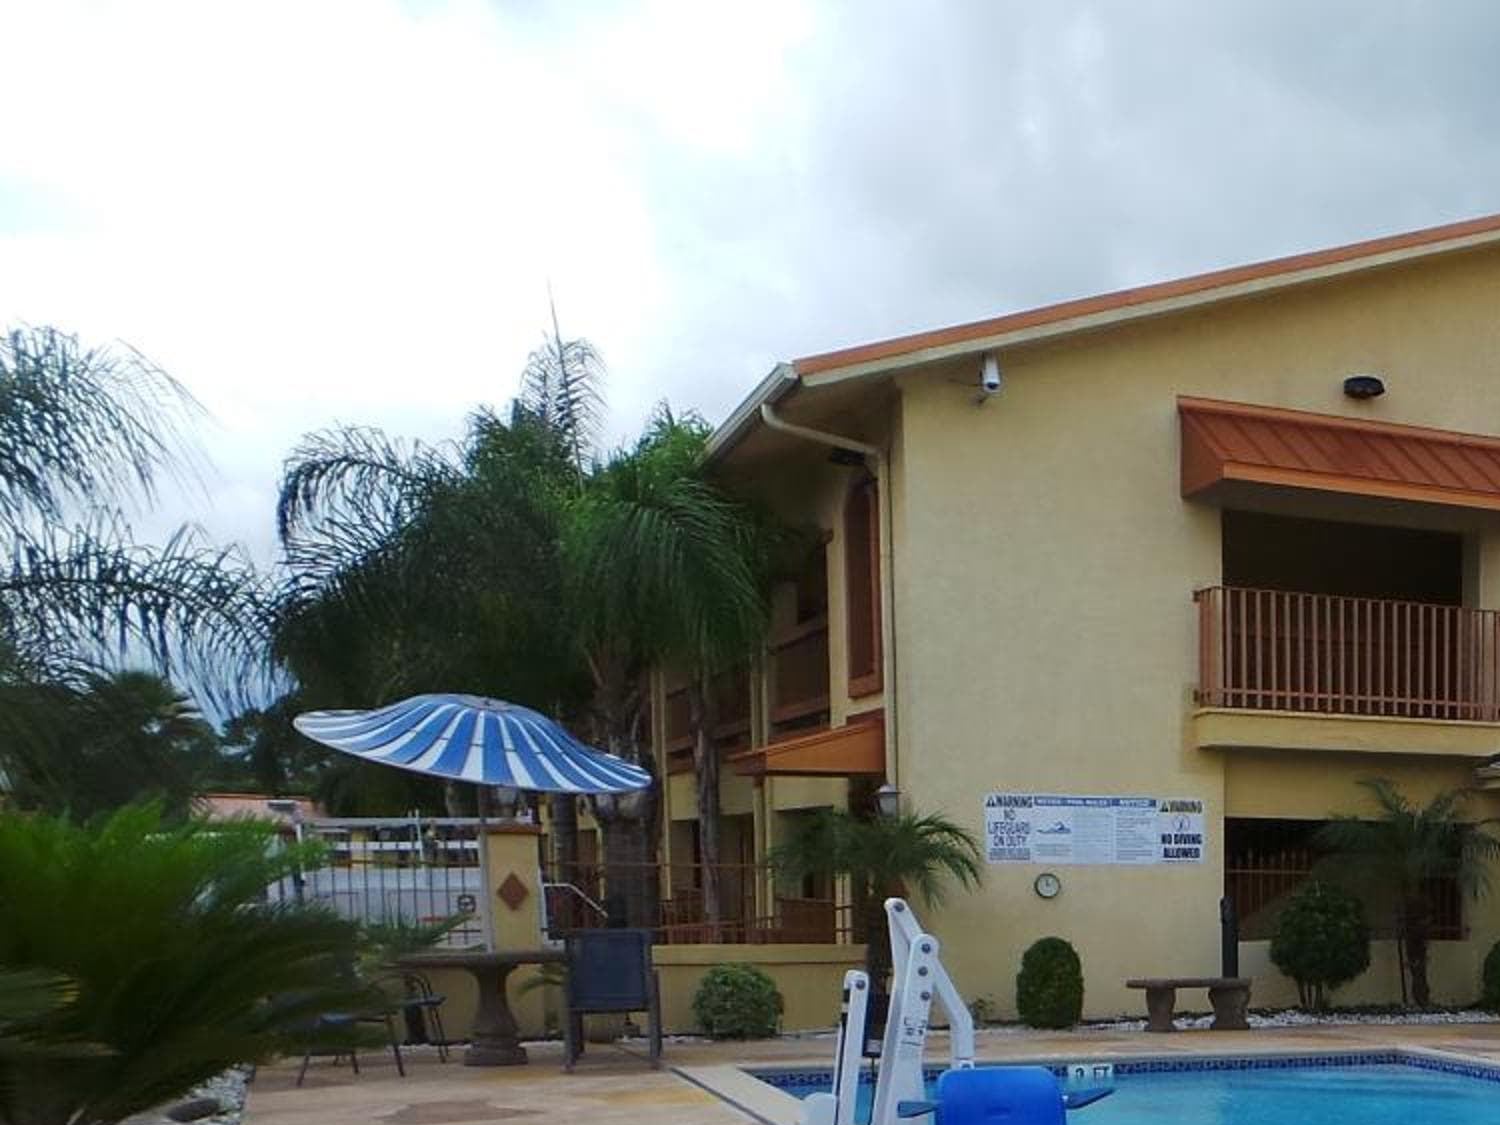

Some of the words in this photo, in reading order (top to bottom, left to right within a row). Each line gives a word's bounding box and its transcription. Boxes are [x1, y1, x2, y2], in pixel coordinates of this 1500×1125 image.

[988, 821, 1030, 835] LIFEGUARD
[993, 834, 1006, 847] ON
[1161, 833, 1173, 845] NO
[1173, 833, 1203, 845] DIVING
[1163, 847, 1201, 859] ALLOWED
